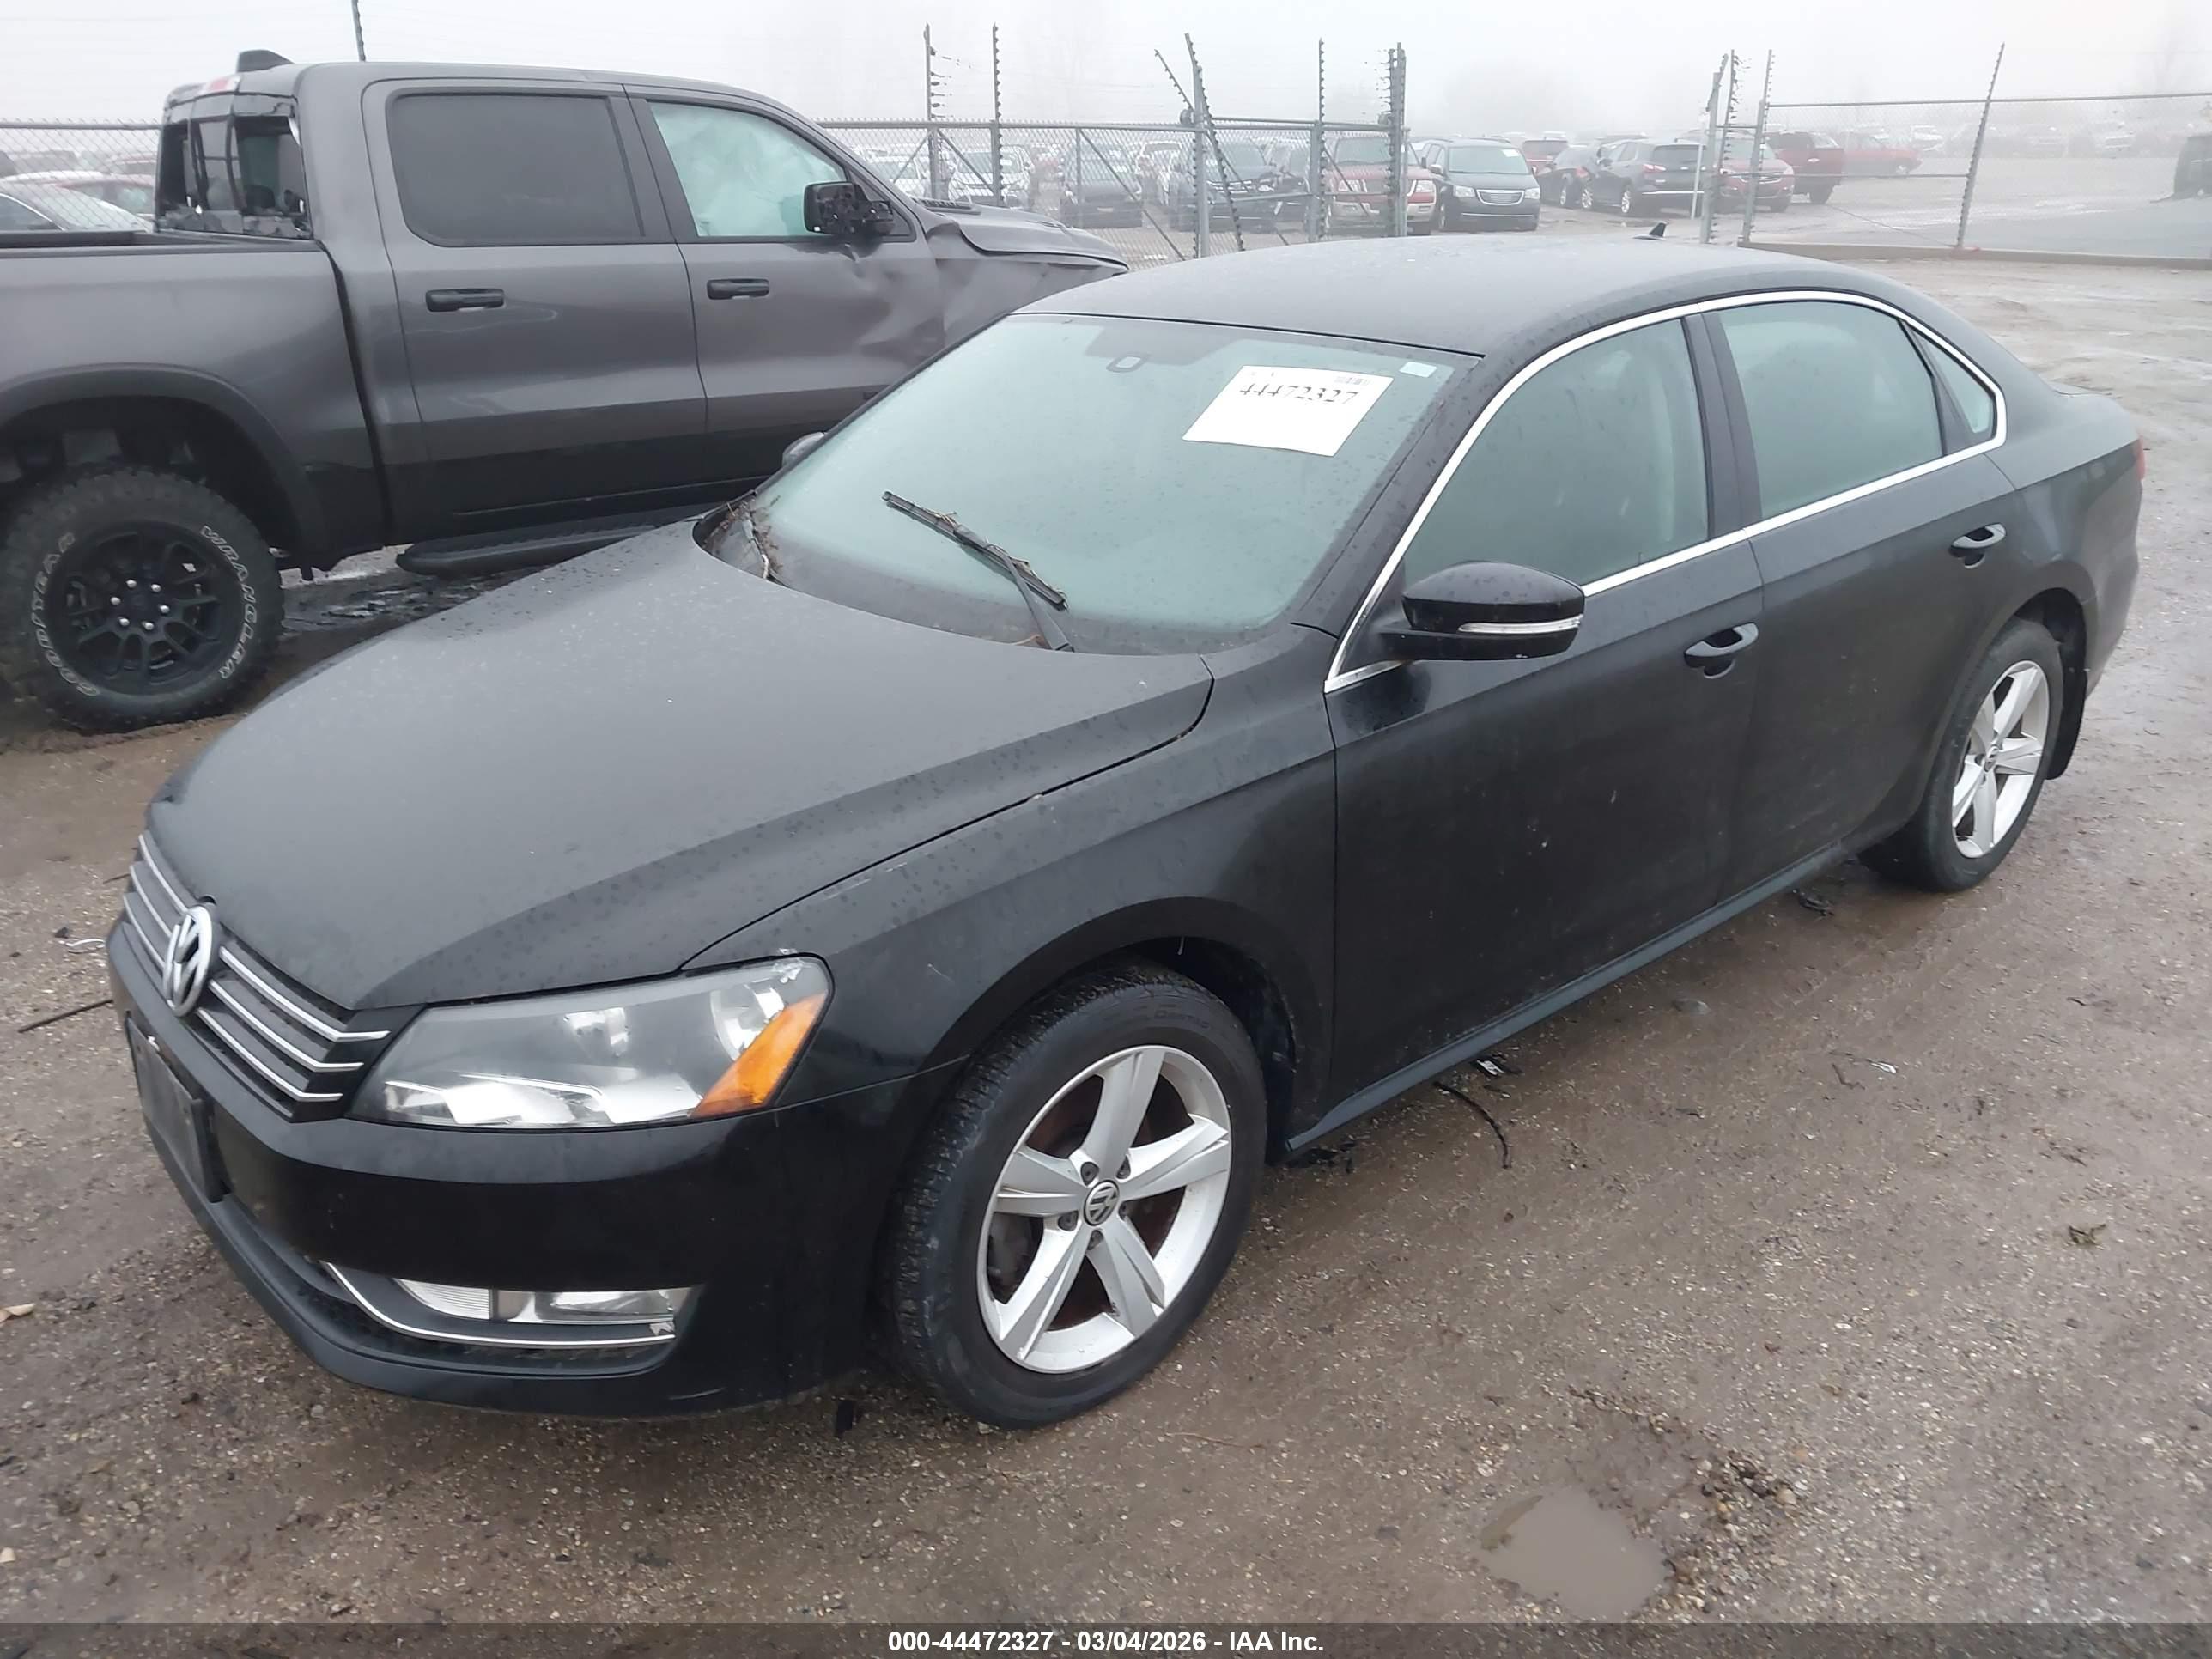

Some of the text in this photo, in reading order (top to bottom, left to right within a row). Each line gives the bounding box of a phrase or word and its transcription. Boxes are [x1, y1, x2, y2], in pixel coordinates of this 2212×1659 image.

[1240, 383, 1359, 405] 44472327
[30, 532, 100, 696] GOODYEAR
[199, 525, 258, 680] WRANGLER
